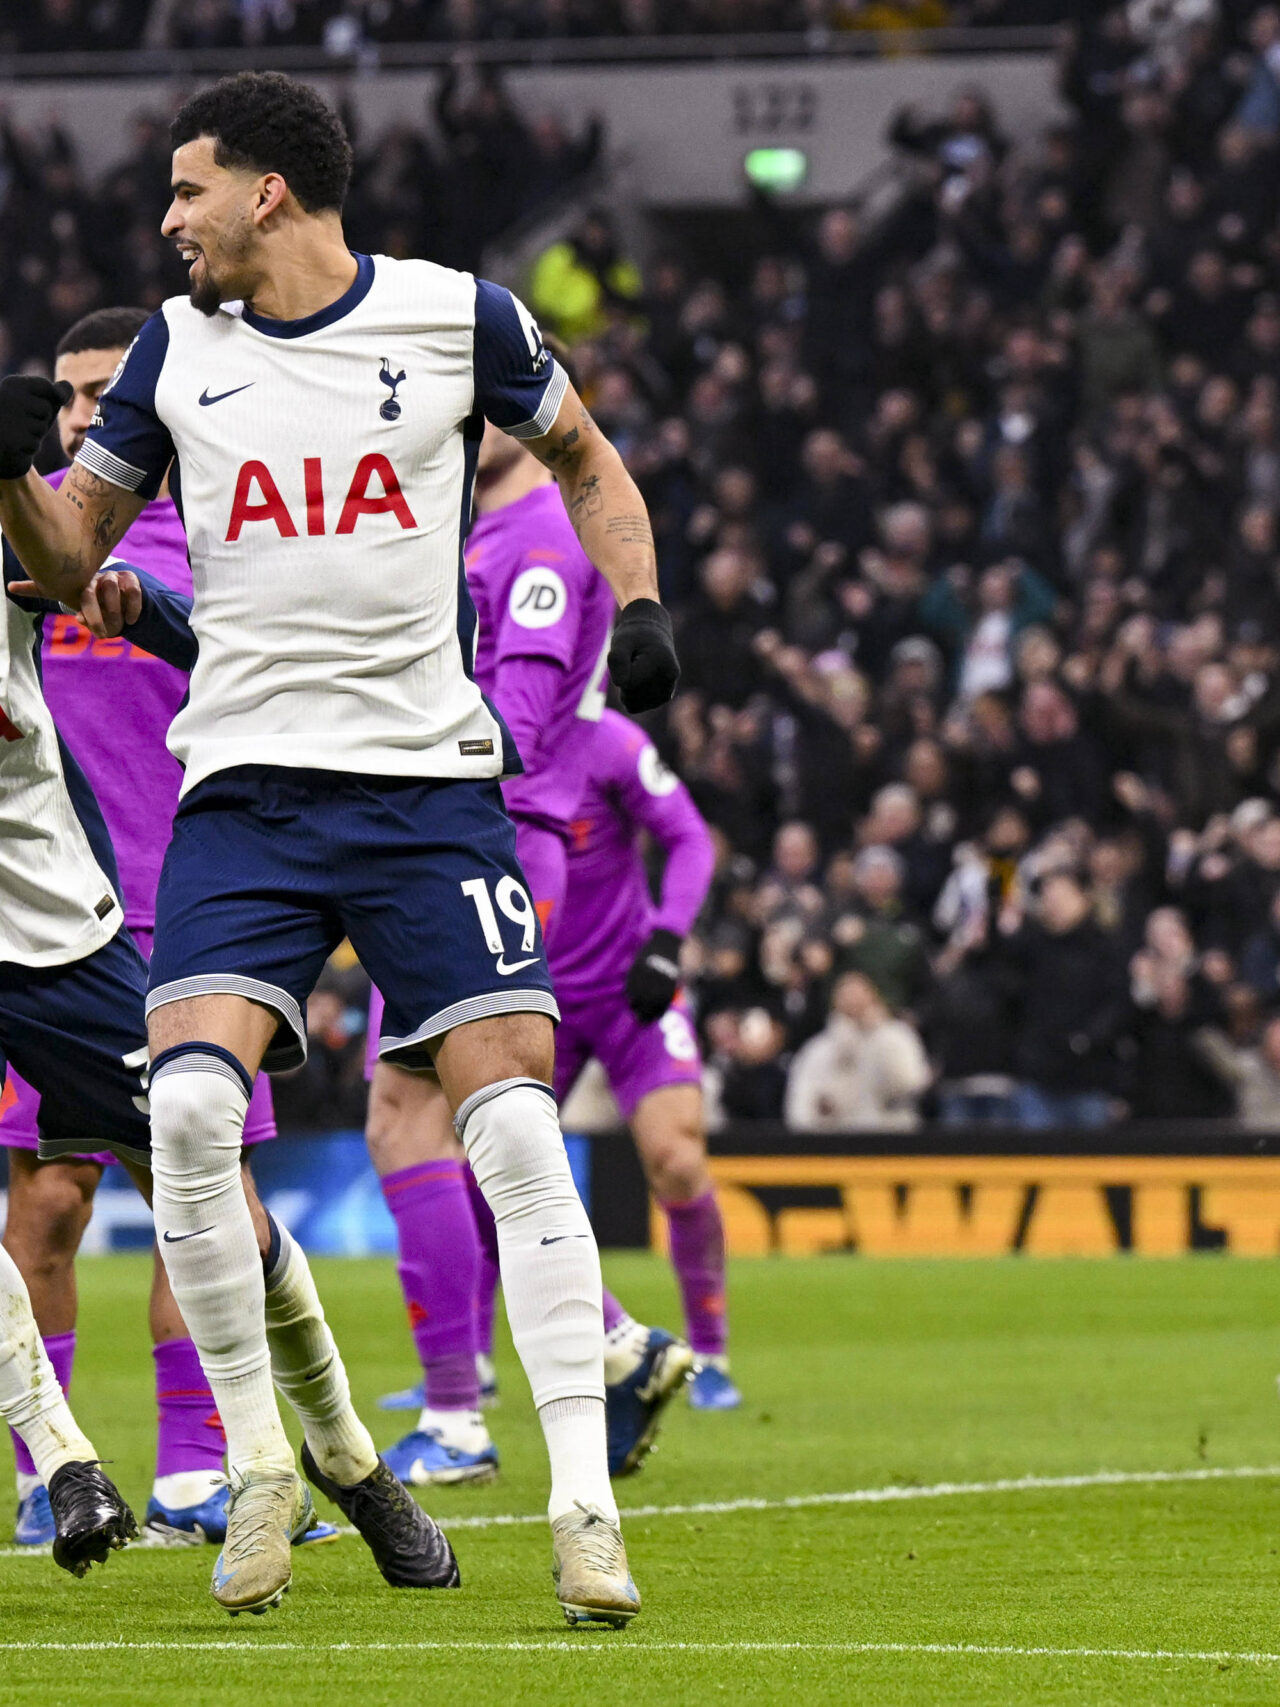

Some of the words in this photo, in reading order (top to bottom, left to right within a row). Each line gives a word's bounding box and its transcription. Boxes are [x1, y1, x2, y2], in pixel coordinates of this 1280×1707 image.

[224, 453, 418, 541] AIA
[517, 585, 557, 610] JD
[460, 875, 535, 954] 19
